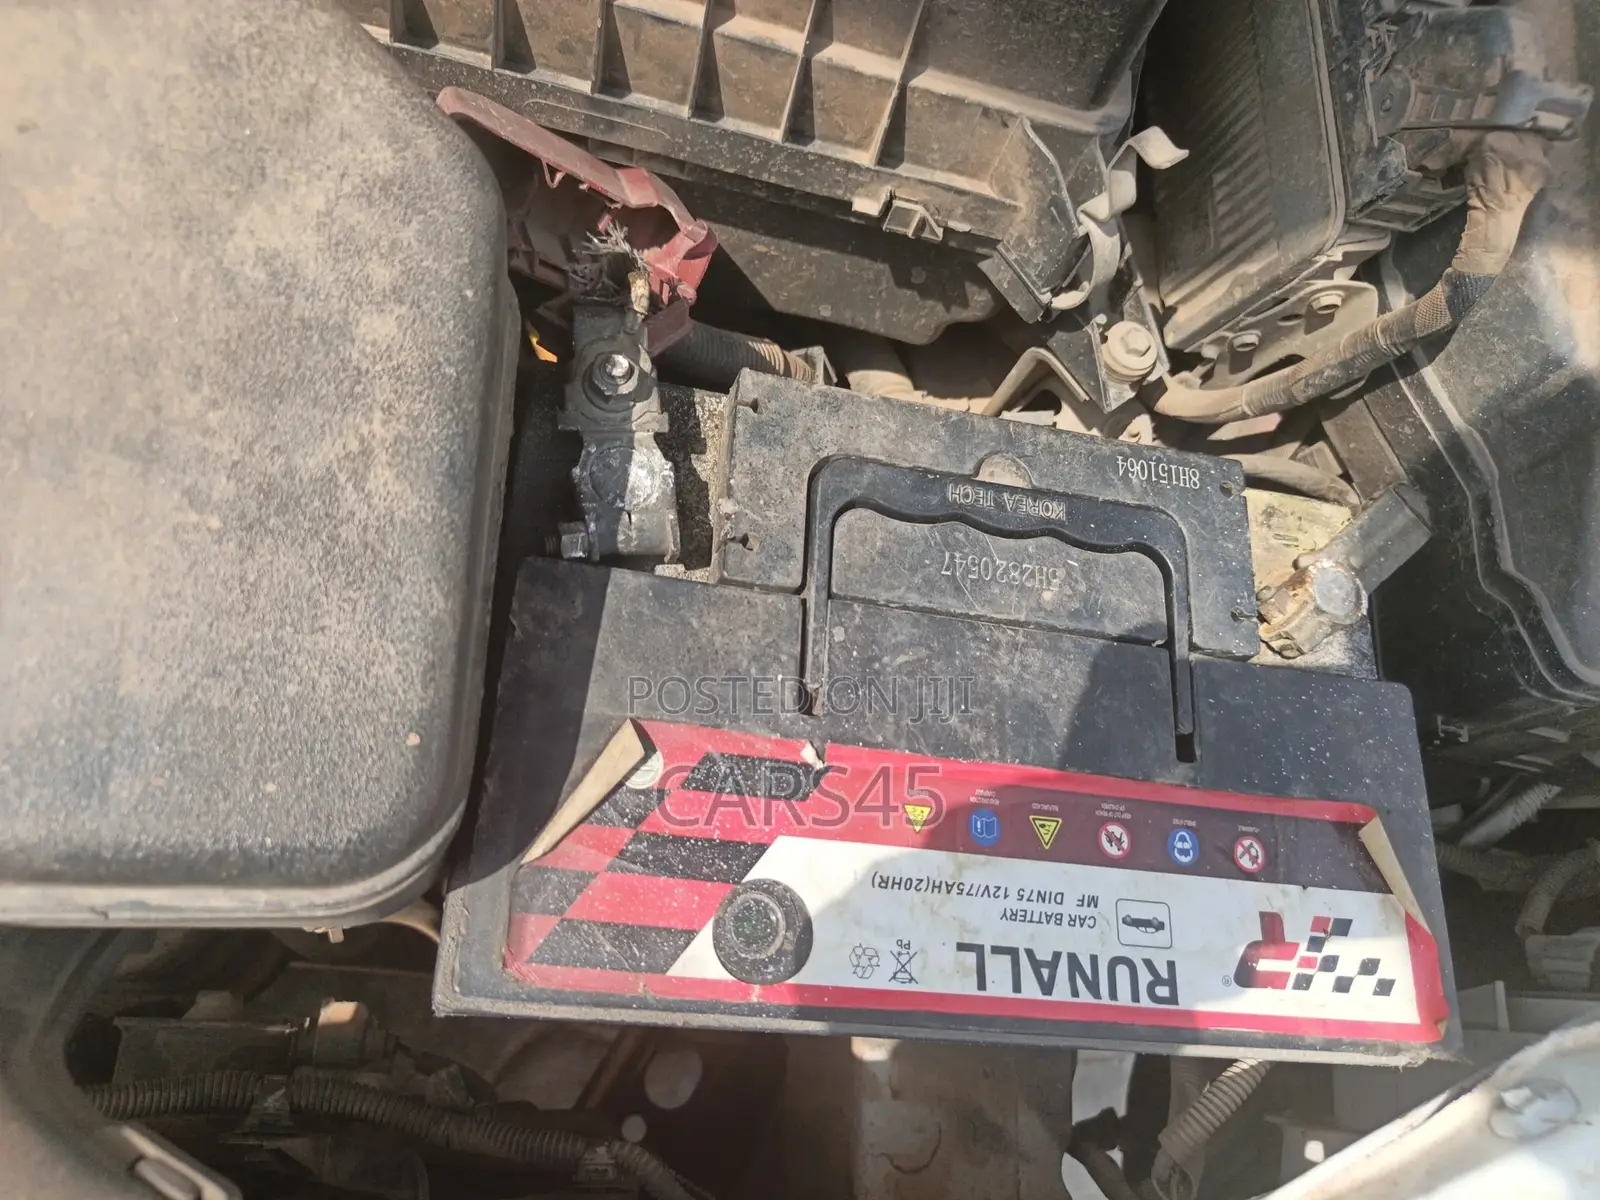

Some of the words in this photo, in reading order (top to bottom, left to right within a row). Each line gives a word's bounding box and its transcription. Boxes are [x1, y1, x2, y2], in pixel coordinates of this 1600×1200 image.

[1116, 455, 1200, 489] 8H151064
[948, 482, 997, 508] TECH
[1003, 491, 1066, 521] KOREA
[940, 551, 1060, 591] 5H2820547
[870, 872, 1011, 900] 12V/75AH(20HR)
[1016, 888, 1065, 906] DIN75
[1076, 893, 1099, 909] MF
[999, 906, 1064, 926] BATTERY
[1067, 913, 1097, 929] CAR
[896, 938, 911, 950] Pb
[956, 941, 1179, 1006] RUNALL
